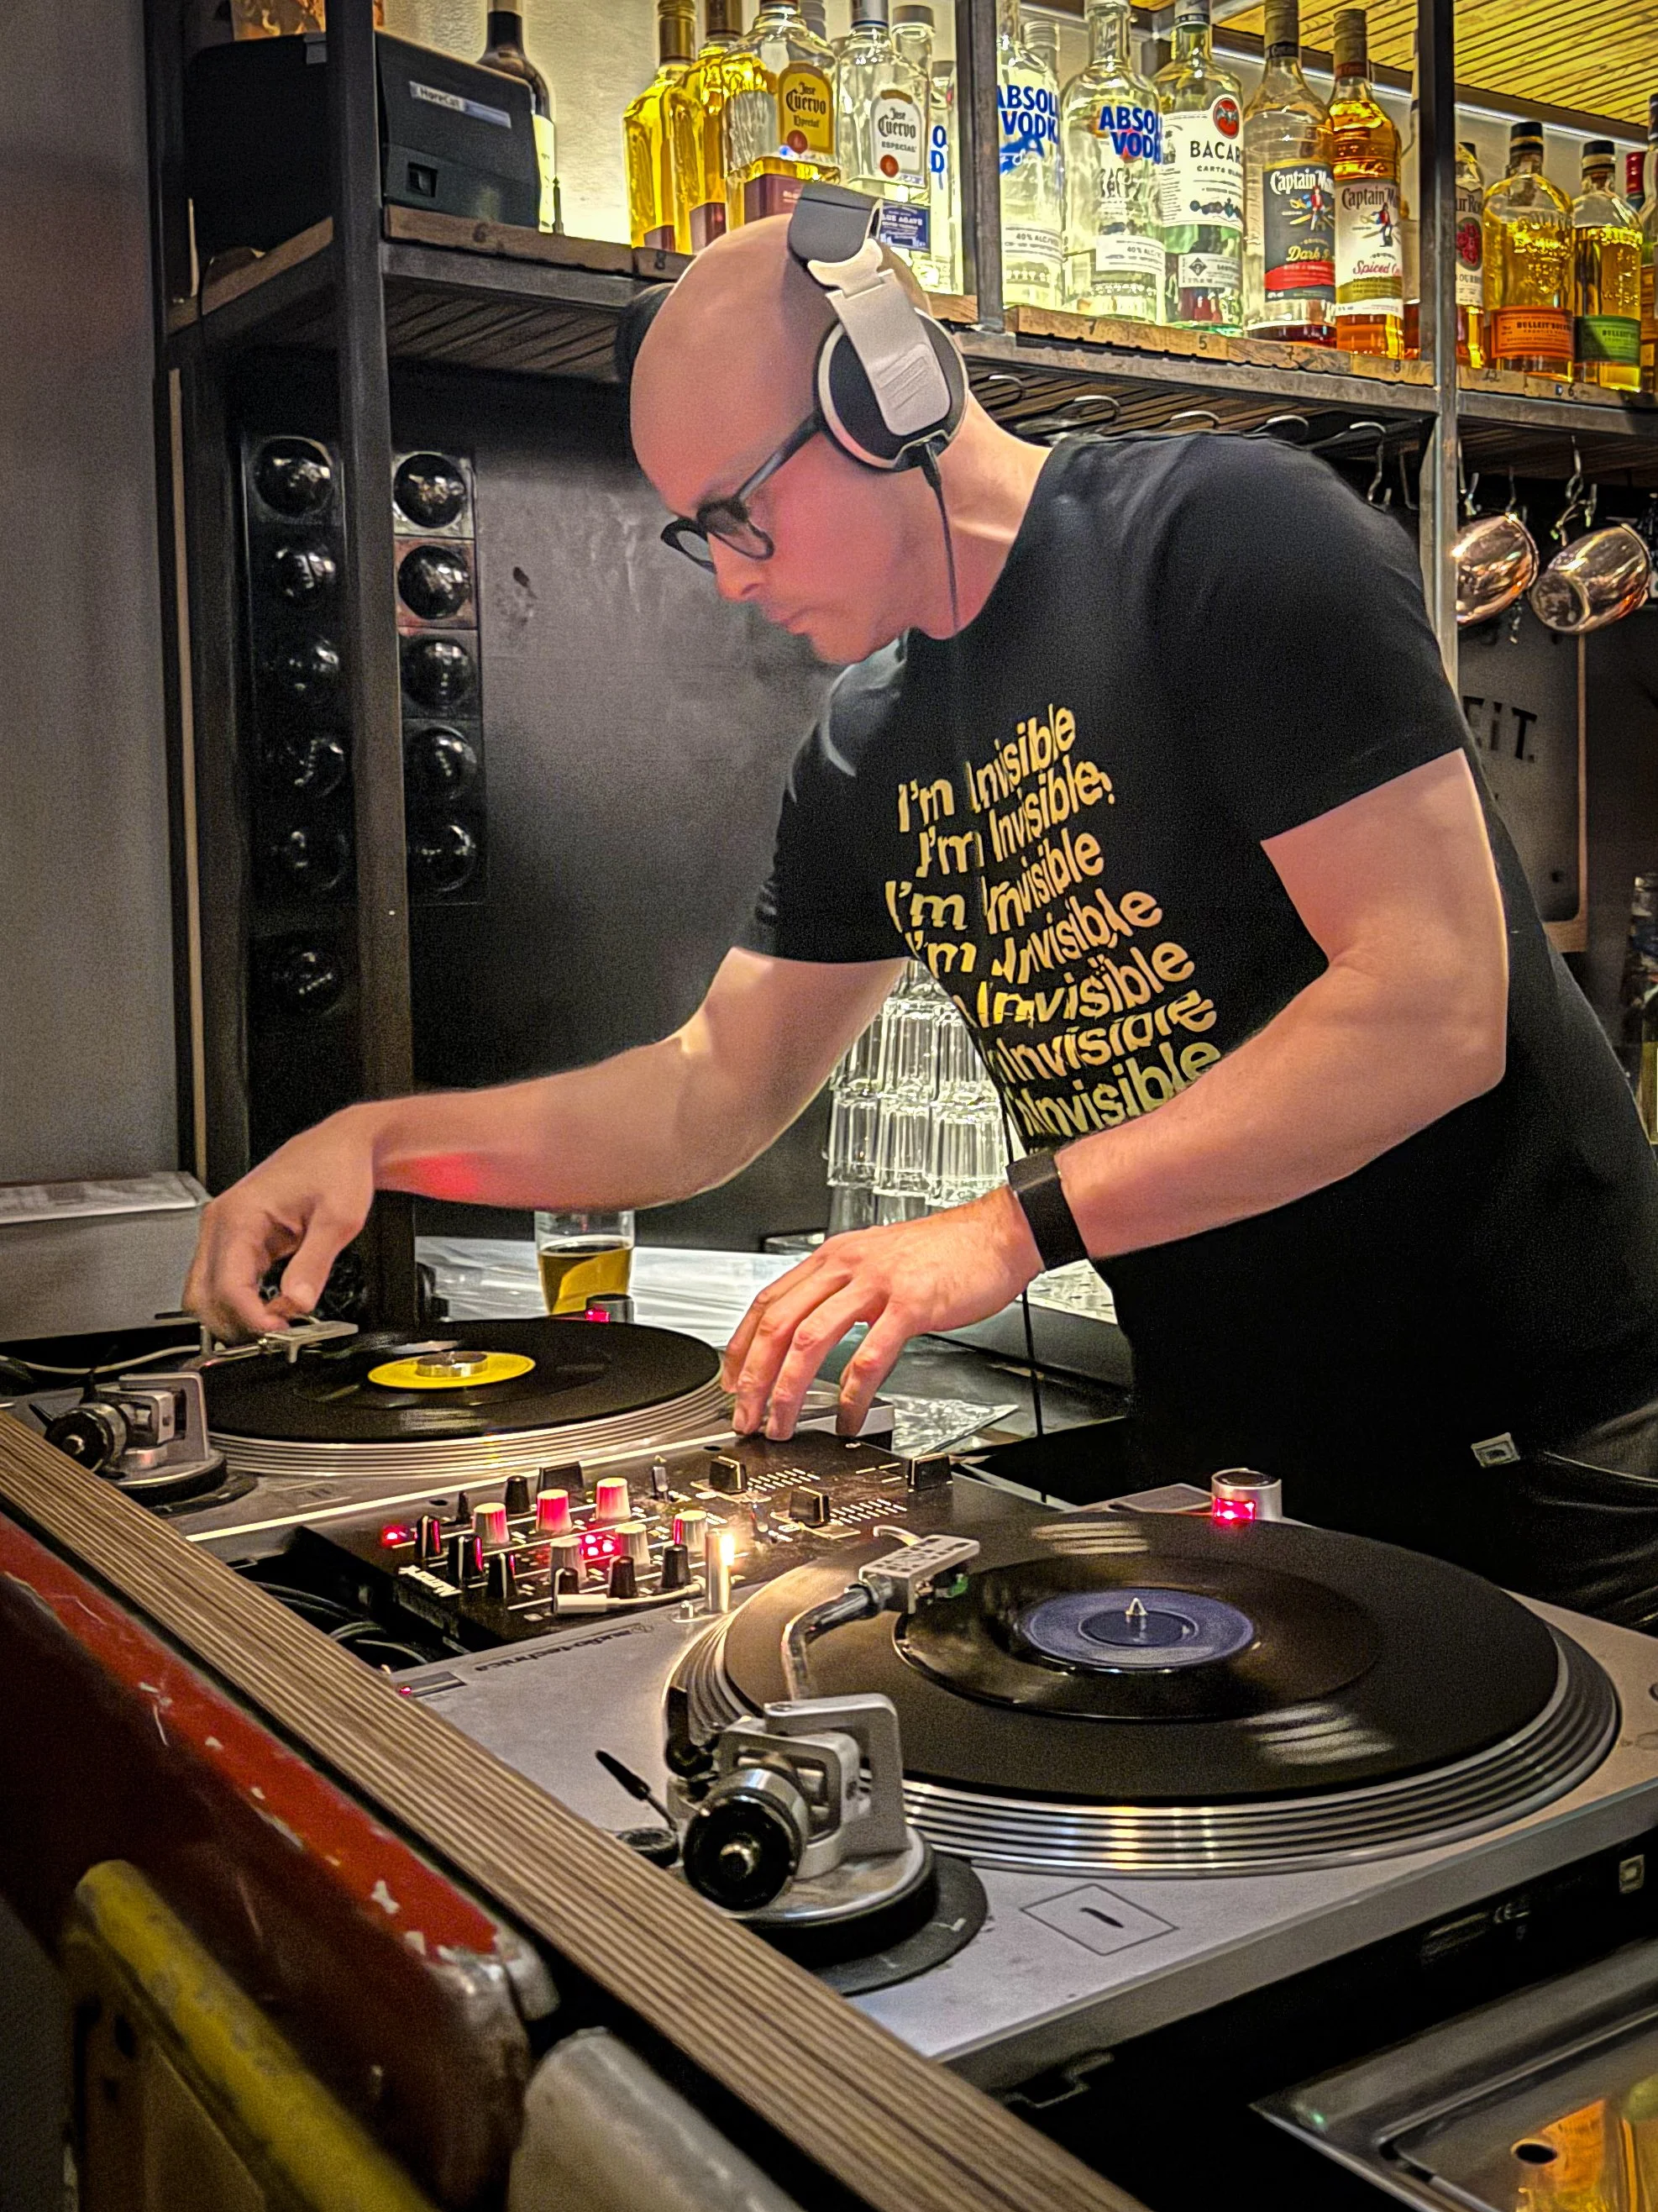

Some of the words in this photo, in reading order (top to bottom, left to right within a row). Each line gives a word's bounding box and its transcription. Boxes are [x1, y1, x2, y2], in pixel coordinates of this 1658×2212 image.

[786, 88, 826, 114] Cuervo
[878, 114, 916, 139] Cuervo
[1270, 168, 1316, 195] Captain
[1341, 186, 1385, 210] Captain
[1286, 245, 1320, 261] Dark
[1353, 260, 1391, 275] Spiced
[1199, 335, 1208, 350] 5
[885, 880, 968, 933] I'm
